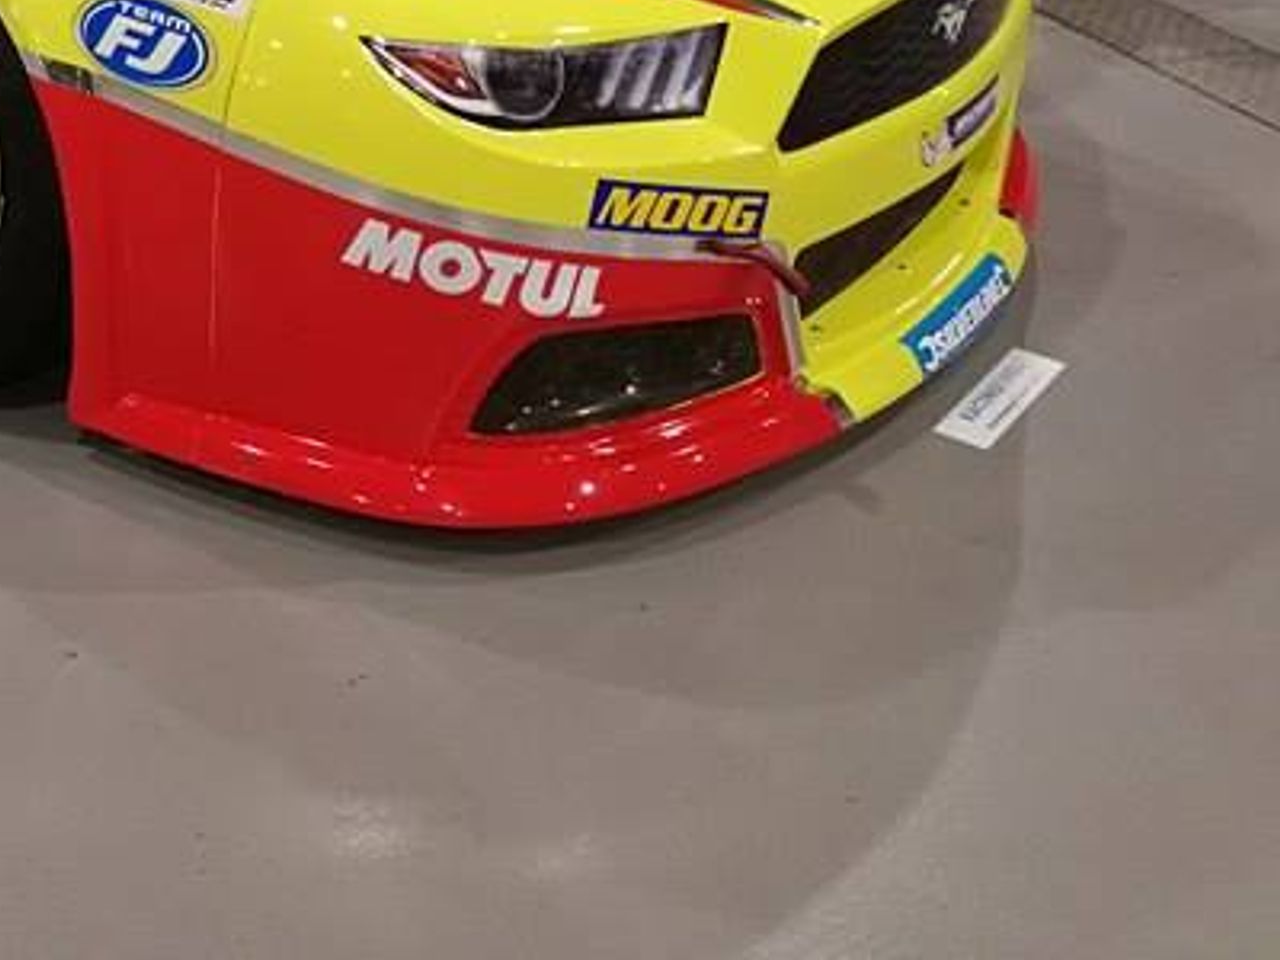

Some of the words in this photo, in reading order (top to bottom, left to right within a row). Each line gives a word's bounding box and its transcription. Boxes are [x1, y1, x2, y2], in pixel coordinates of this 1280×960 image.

[93, 13, 188, 75] FJ
[594, 187, 764, 235] MOOG
[341, 217, 606, 320] MOTUL
